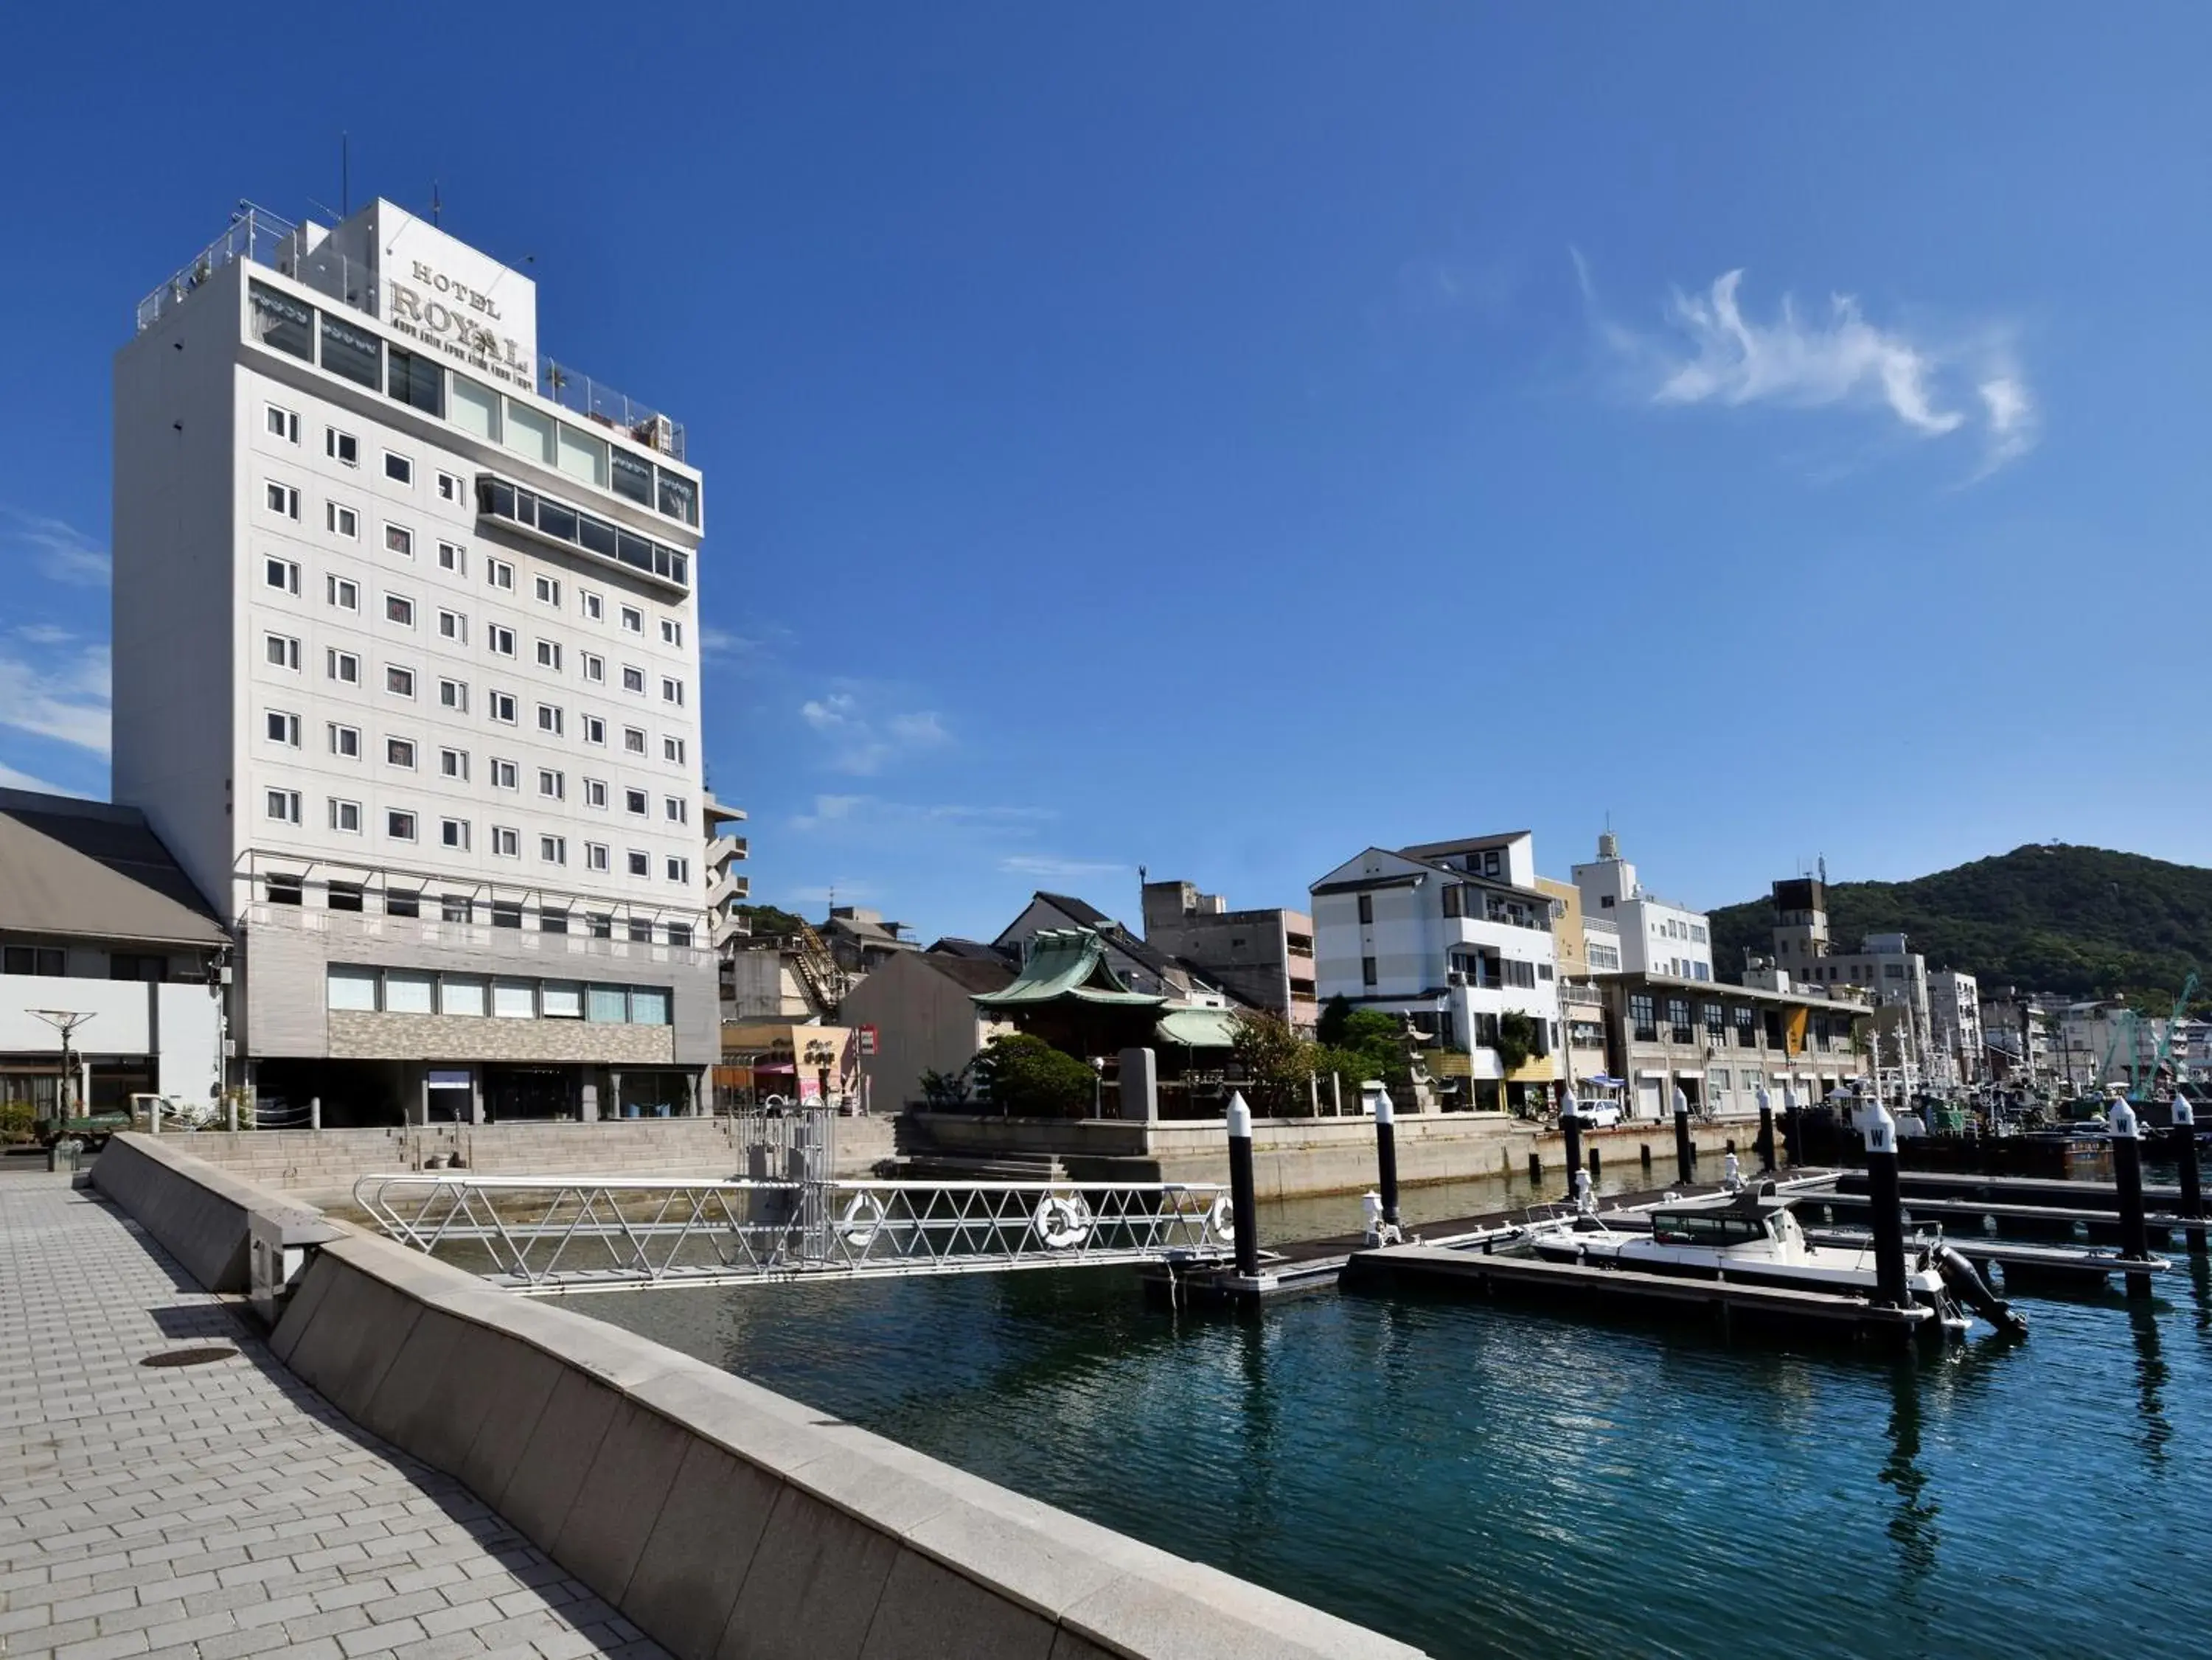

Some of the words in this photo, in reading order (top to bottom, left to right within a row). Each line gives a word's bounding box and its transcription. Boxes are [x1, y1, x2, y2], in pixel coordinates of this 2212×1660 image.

[412, 259, 501, 321] HOTEL
[391, 281, 529, 374] ROYAL
[2177, 1110, 2187, 1121] W
[2116, 1118, 2127, 1133] W
[1871, 1129, 1884, 1147] W
